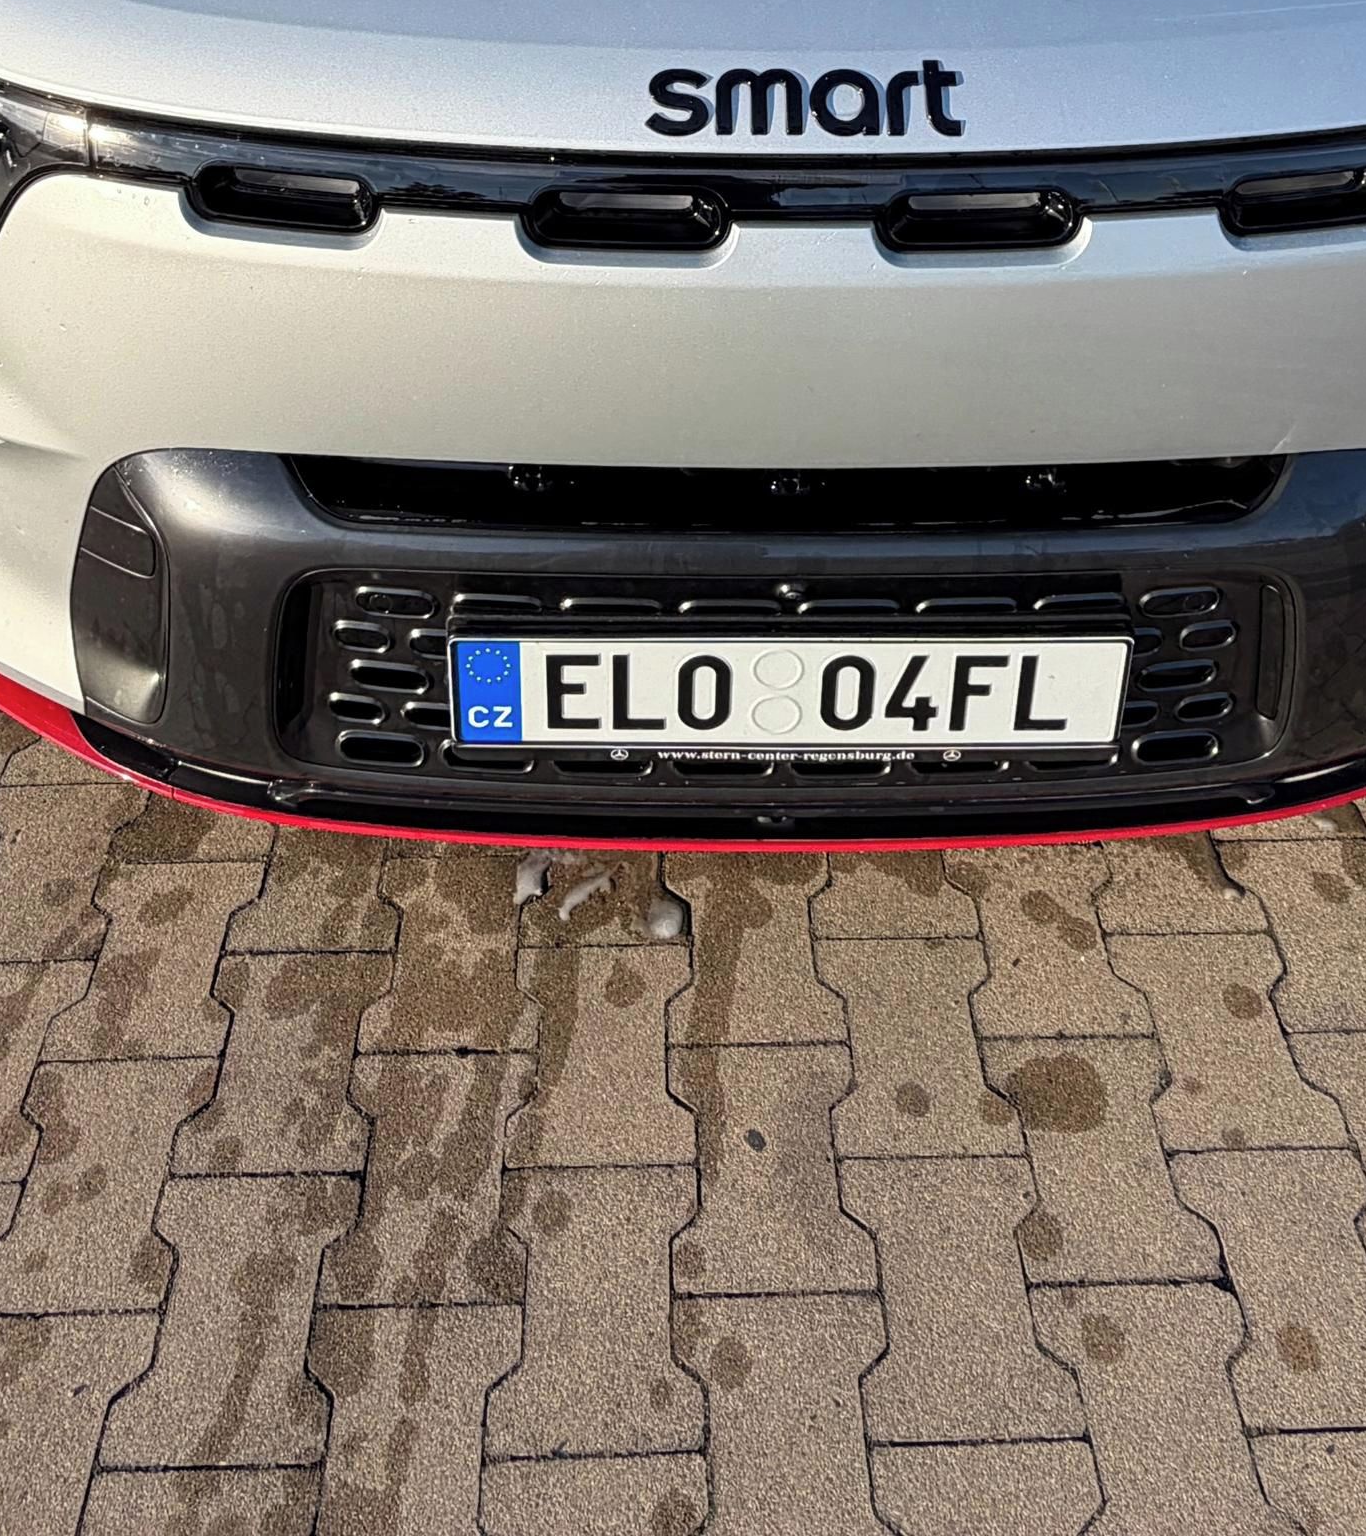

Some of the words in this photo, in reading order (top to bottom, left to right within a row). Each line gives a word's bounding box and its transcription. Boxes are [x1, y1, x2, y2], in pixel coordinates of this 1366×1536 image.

[645, 60, 965, 136] smart
[468, 706, 513, 728] CZ
[820, 653, 1068, 732] 04FL
[657, 750, 915, 762] www.stern-center-regensburg.de
